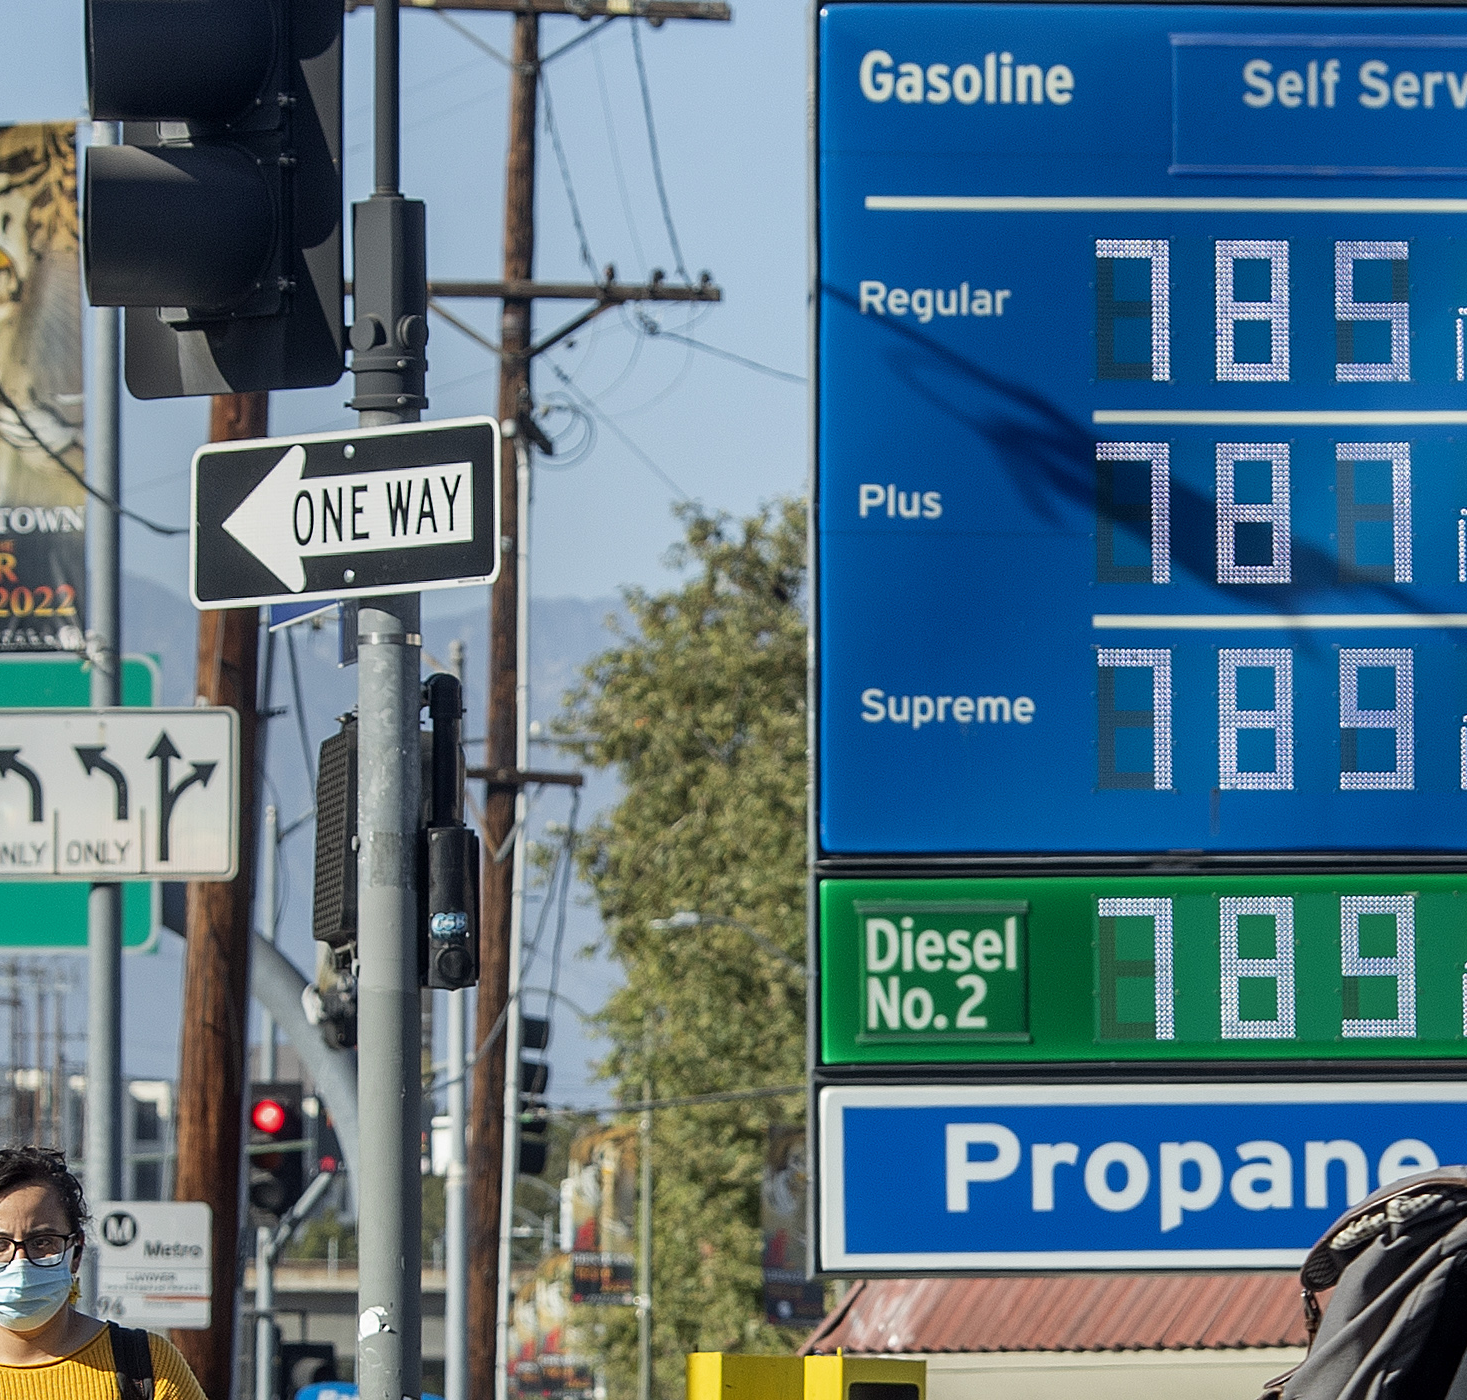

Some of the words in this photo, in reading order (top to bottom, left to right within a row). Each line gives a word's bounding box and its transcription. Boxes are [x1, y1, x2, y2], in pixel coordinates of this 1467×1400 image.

[859, 50, 1075, 104] Gasoline
[1242, 59, 1341, 108] Self
[859, 280, 1011, 323] Regular
[1095, 239, 1411, 382] 785
[293, 484, 370, 546] ONE
[385, 473, 462, 537] WAY
[859, 484, 943, 519] Plus
[1095, 442, 1413, 584] 787
[860, 687, 1035, 728] Supreme
[1097, 648, 1414, 790] 789
[65, 841, 131, 867] ONLY
[866, 918, 1018, 972] Diesel
[1098, 895, 1417, 1040] 789
[866, 978, 948, 1031] No.
[956, 974, 988, 1028] 2
[143, 1240, 204, 1259] Metro
